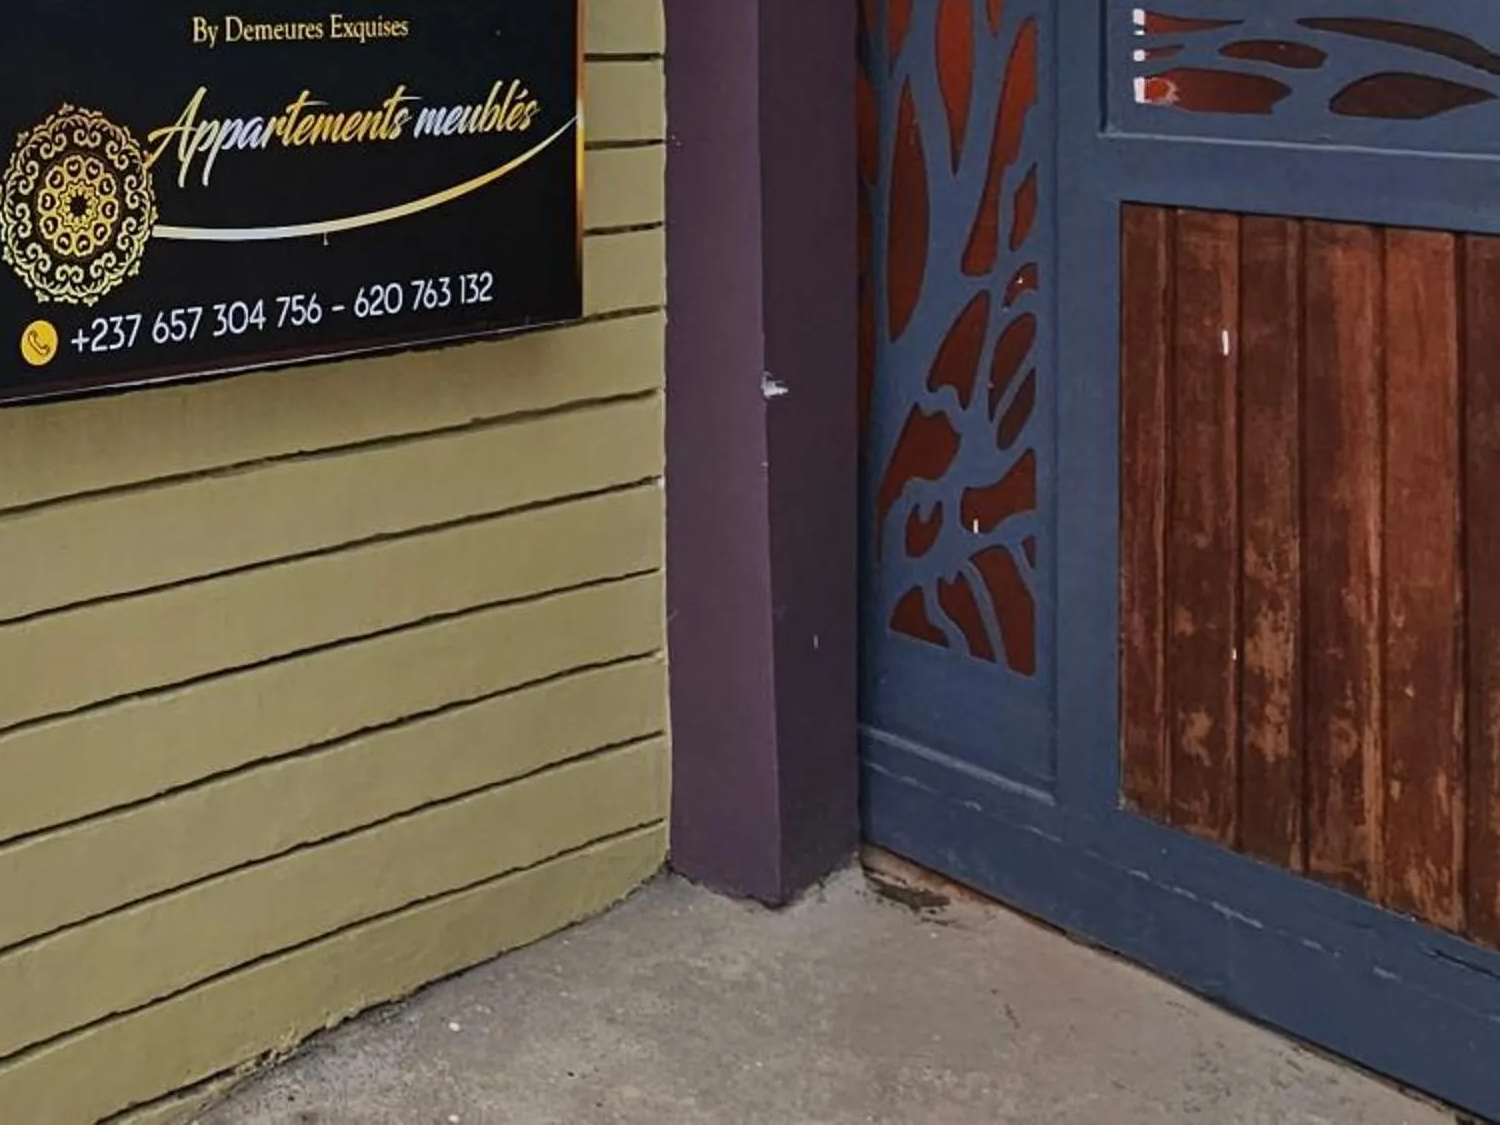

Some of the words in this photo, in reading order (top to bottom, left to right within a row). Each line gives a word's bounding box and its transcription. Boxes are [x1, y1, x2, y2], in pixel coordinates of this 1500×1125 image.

[193, 16, 217, 48] By
[225, 16, 324, 42] Demeures
[330, 14, 409, 44] Exquises
[146, 85, 421, 188] Appartements
[413, 78, 538, 139] meublés
[70, 313, 142, 353] +237
[151, 306, 203, 345] 657
[212, 298, 267, 338] 304
[275, 292, 323, 329] 756
[353, 282, 403, 319] 620
[410, 276, 452, 311] 763
[459, 271, 494, 305] 132
